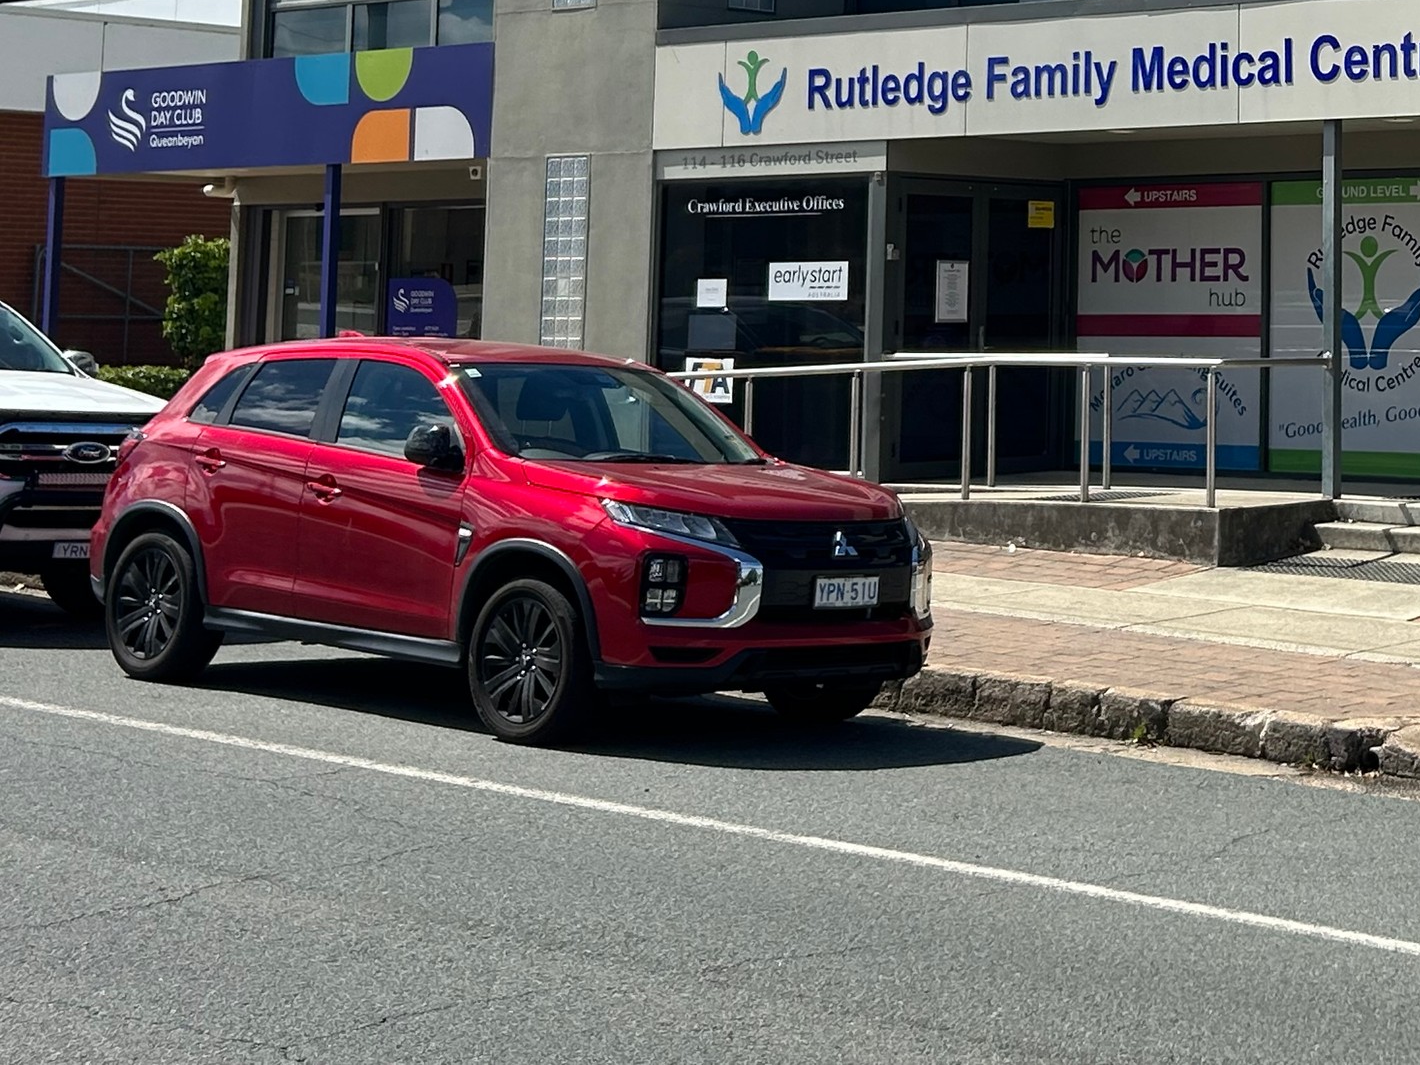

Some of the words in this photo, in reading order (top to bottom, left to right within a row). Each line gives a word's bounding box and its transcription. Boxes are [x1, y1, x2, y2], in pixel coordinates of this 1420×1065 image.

[807, 62, 972, 115] Rutledge
[986, 50, 1118, 108] Family
[1132, 38, 1293, 93] Medical
[152, 89, 206, 107] GOODWIN
[151, 110, 172, 126] DAY
[174, 108, 202, 124] CLUB
[150, 133, 203, 149] Queanbeyan
[683, 156, 707, 170] 114
[720, 154, 746, 169] 116
[749, 151, 811, 167] Crawford
[815, 149, 858, 164] Street
[1144, 190, 1197, 202] UPSTAIRS
[1316, 186, 1367, 198] GUND
[1370, 185, 1406, 197] LEVEL
[687, 198, 743, 214] Crawford
[745, 197, 800, 212] Executive
[802, 195, 845, 211] Offices
[1090, 226, 1122, 244] the
[1091, 247, 1249, 283] MOTHER
[1209, 288, 1246, 307] hub
[1214, 371, 1247, 416] Suites
[1341, 409, 1381, 430] ealth,
[1143, 449, 1197, 462] UPSTAIRS
[62, 545, 88, 557] YRN
